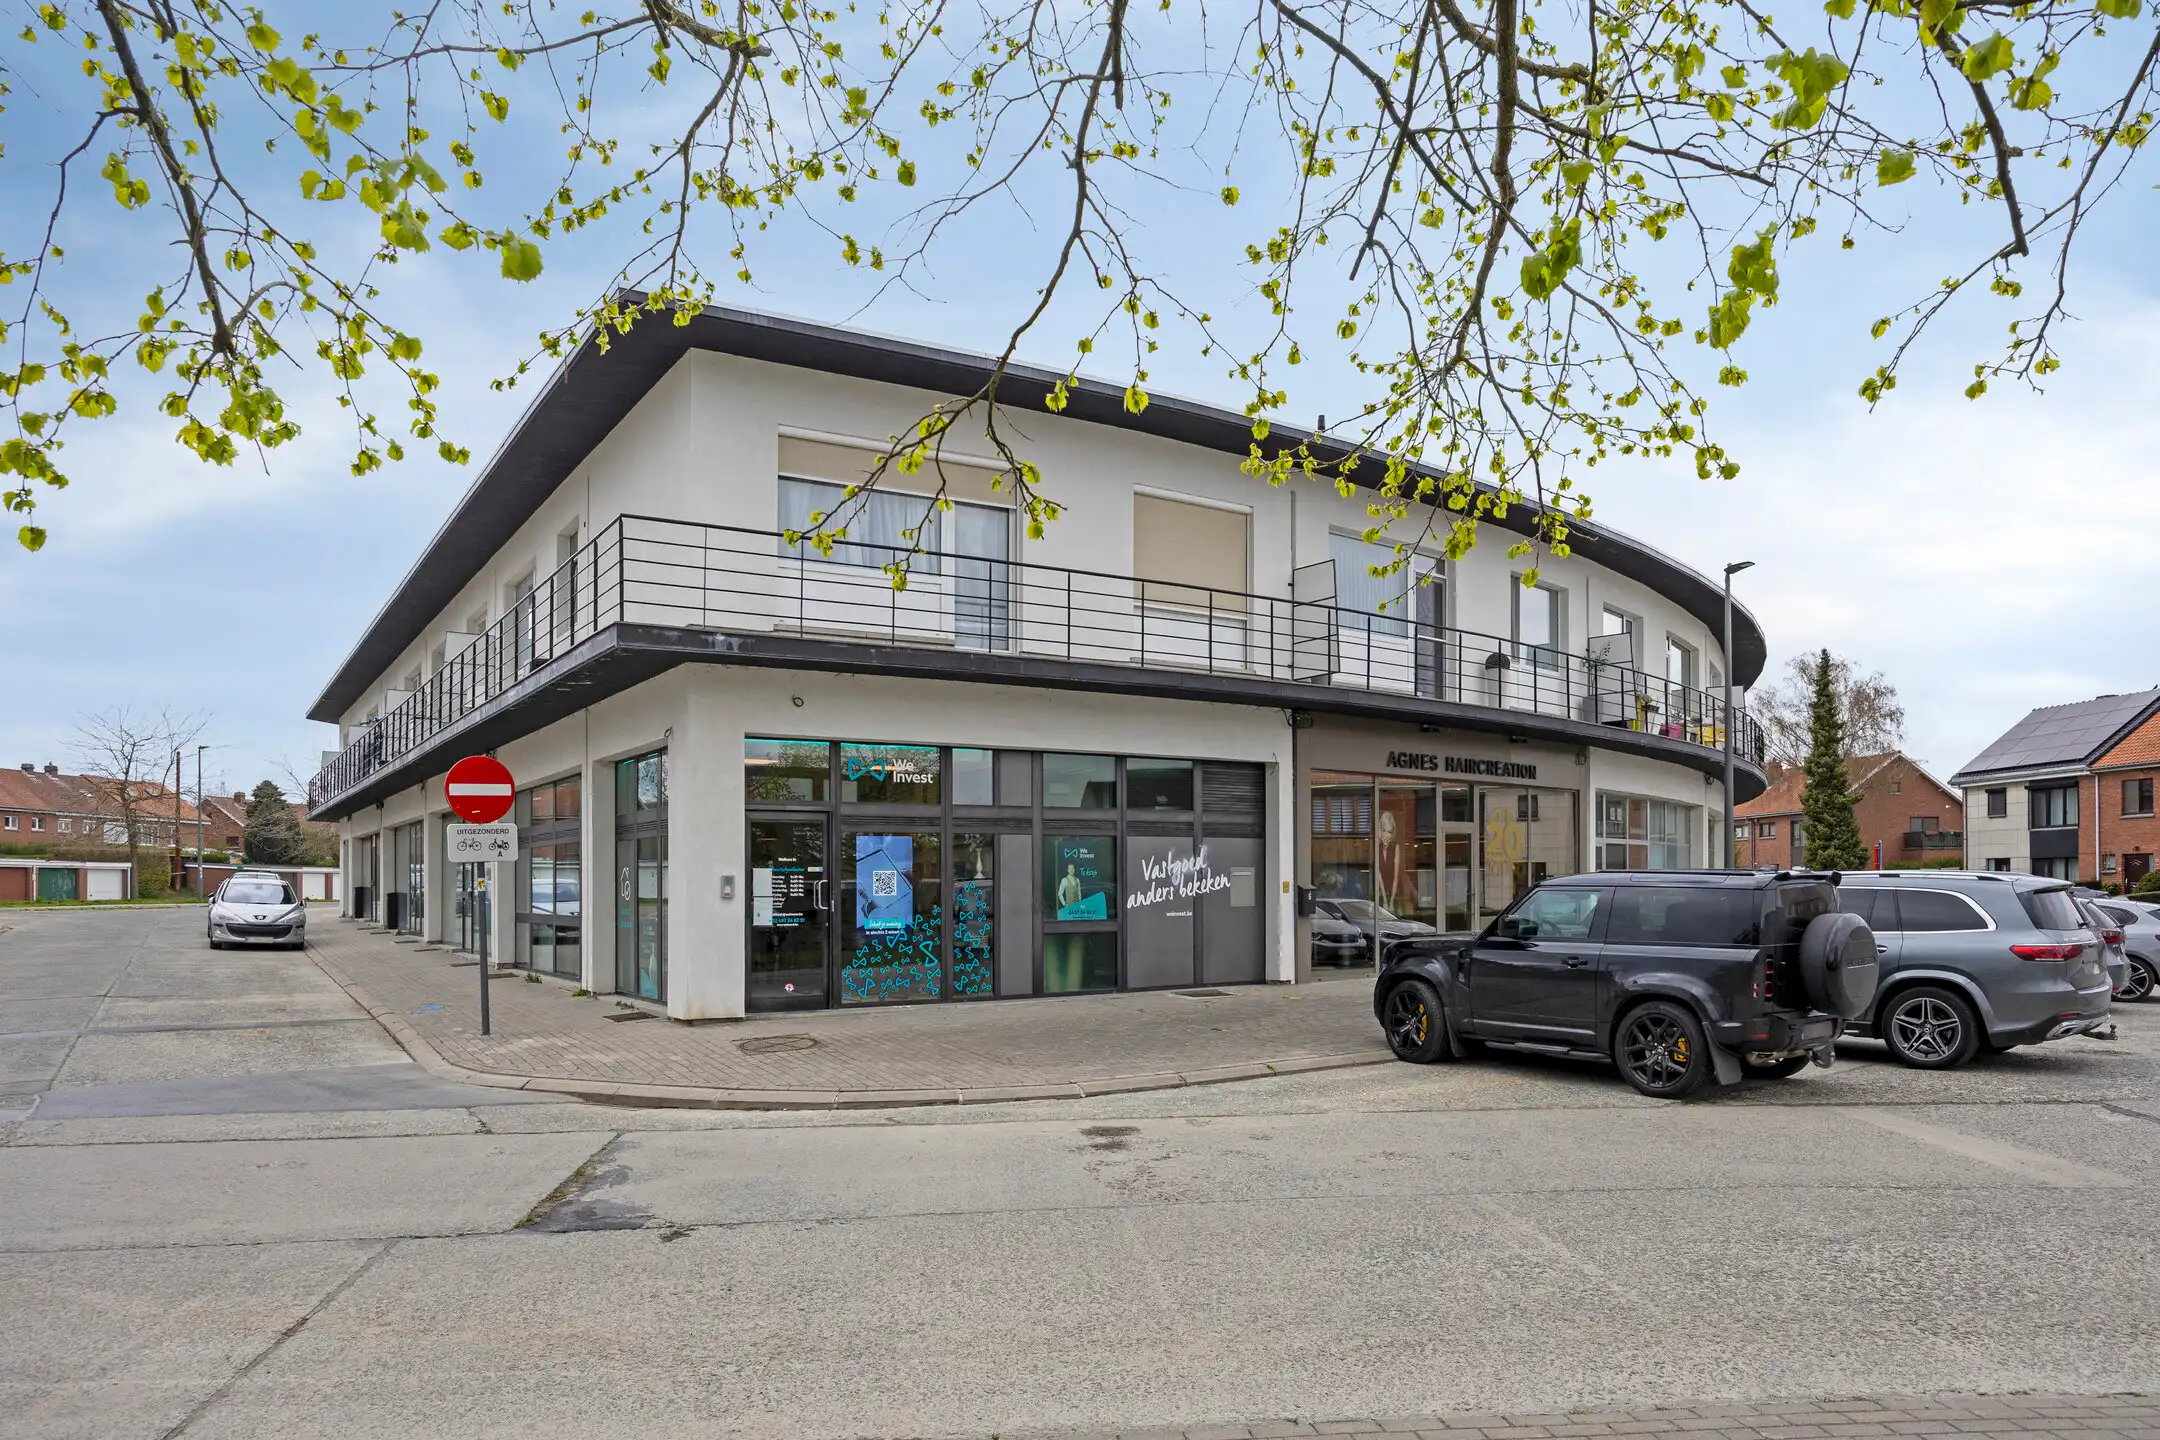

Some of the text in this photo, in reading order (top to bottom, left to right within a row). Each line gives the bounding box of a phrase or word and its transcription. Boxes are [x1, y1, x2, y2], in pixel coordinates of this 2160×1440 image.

[892, 758, 915, 771] We
[1386, 751, 1537, 779] AGNES HAIRCREATION
[892, 770, 934, 784] Invest
[497, 850, 503, 858] A
[1141, 844, 1208, 886] Vastgoed
[1127, 867, 1231, 909] anders bekeken
